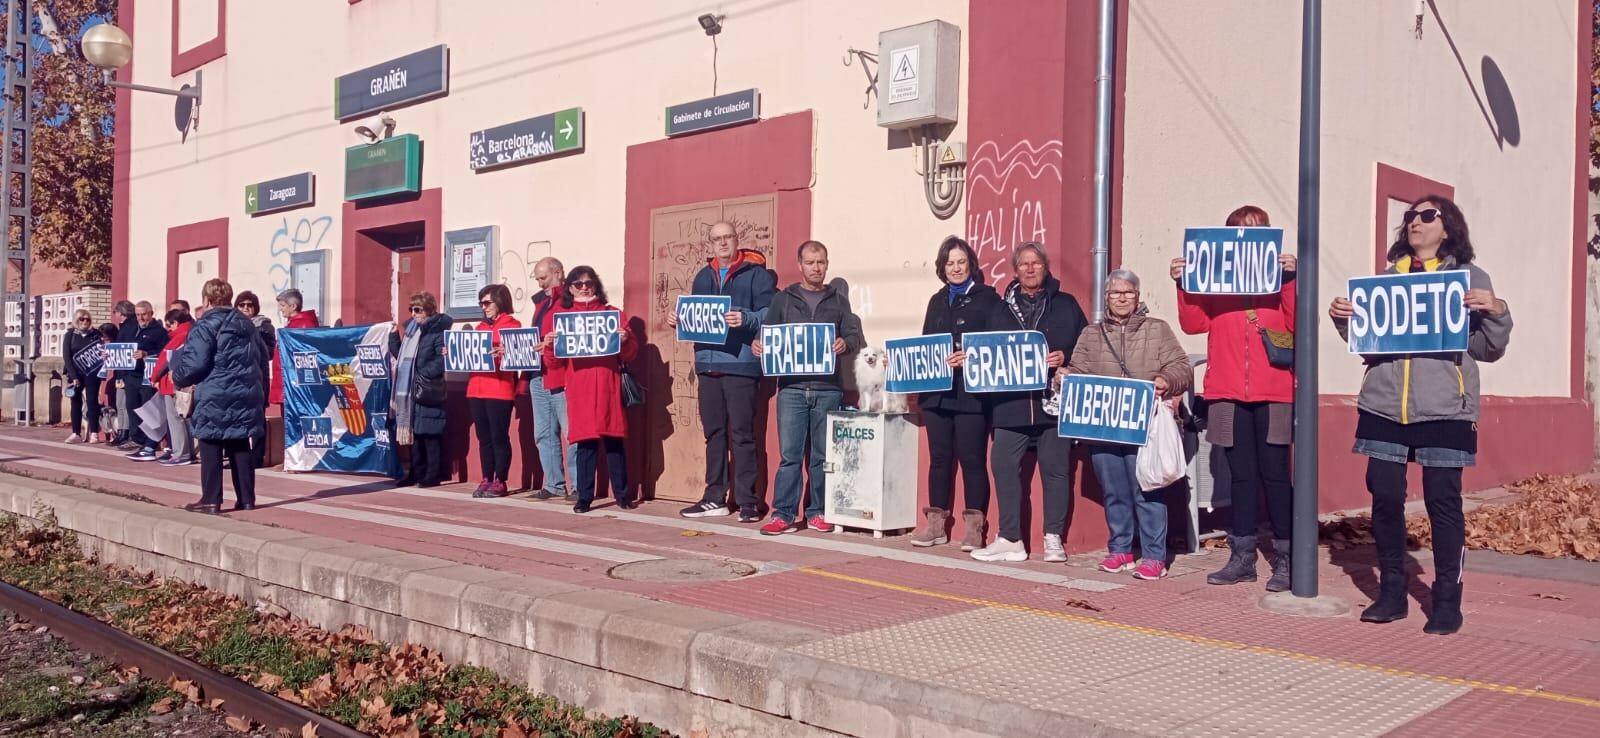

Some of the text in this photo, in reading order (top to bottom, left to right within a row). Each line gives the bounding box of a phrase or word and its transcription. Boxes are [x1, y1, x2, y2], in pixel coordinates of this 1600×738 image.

[370, 67, 407, 96] GRAÑÉN
[673, 100, 750, 125] Gabinete de Circulación
[488, 133, 534, 154] Barcelona
[269, 186, 297, 201] Zaragoza
[1185, 227, 1278, 293] POLEÑINO
[555, 314, 618, 335] ALBERO
[678, 302, 726, 335] ROBRES
[1351, 281, 1465, 338] SODETO
[448, 332, 490, 370] CURBE
[566, 335, 608, 354] BAJO
[762, 326, 833, 374] FRAELLA
[886, 343, 951, 381] MONTESUSIN
[1062, 381, 1148, 431] ALBERUELA
[835, 427, 875, 441] CALCES
